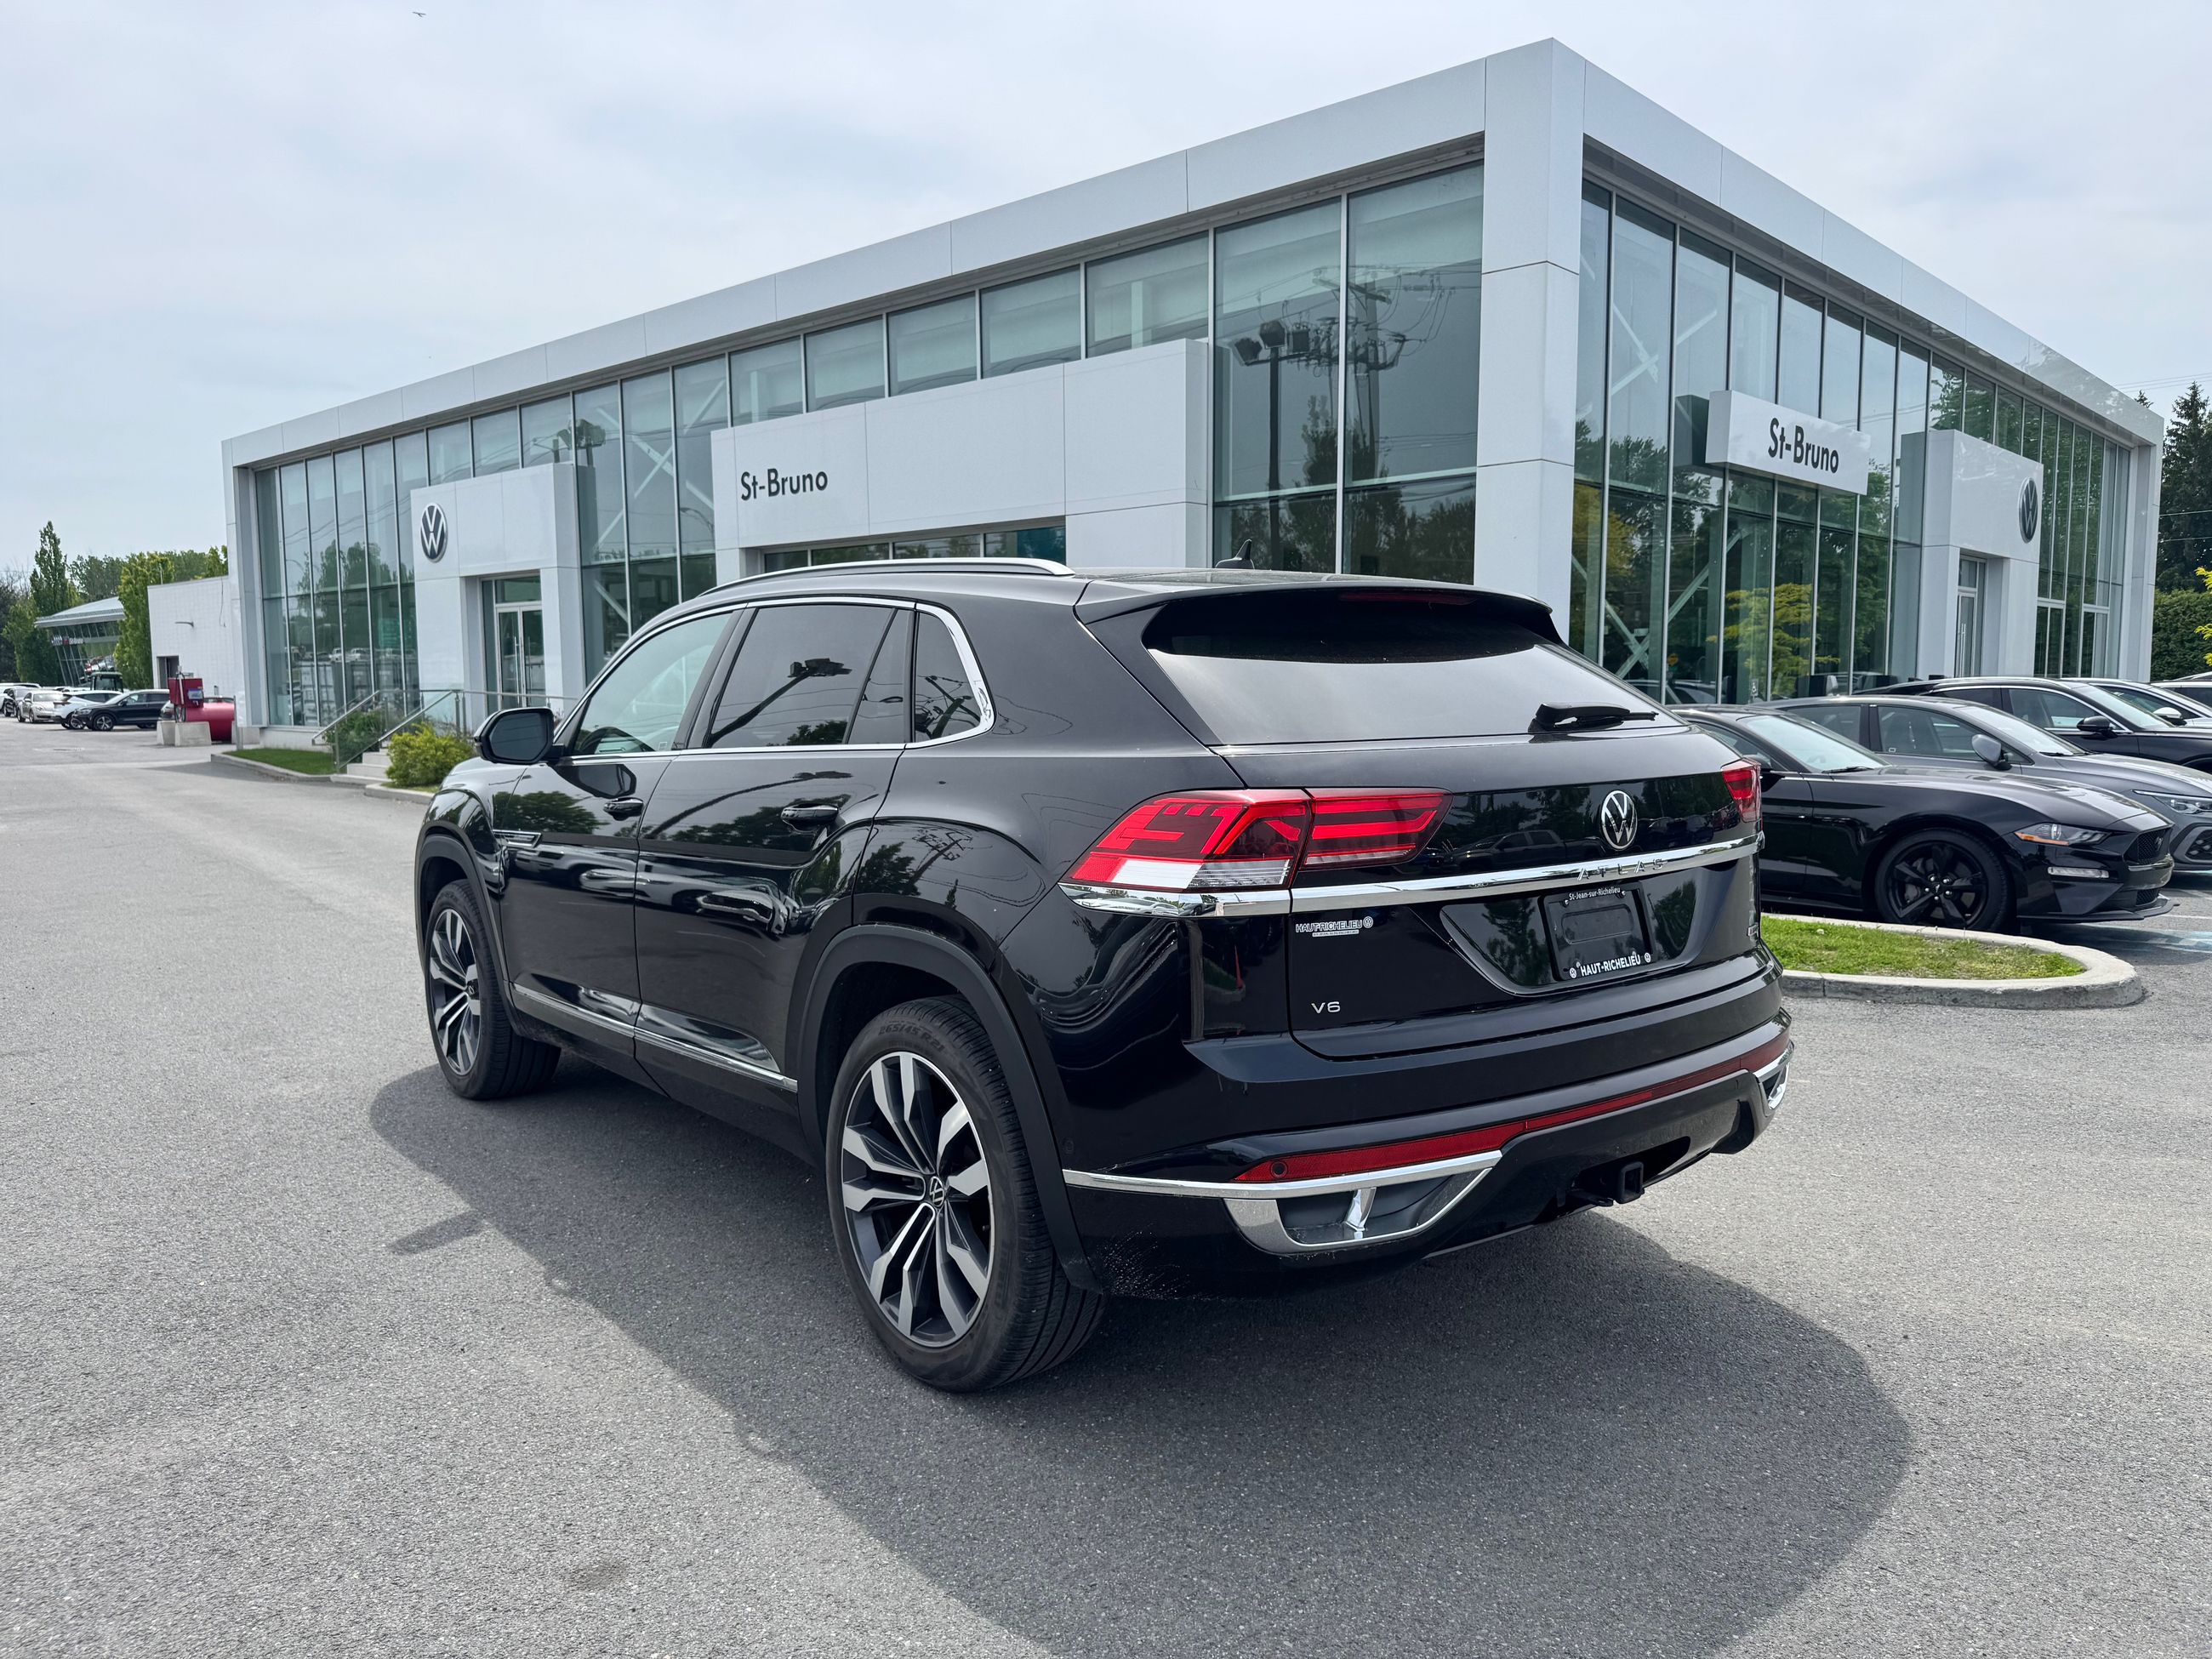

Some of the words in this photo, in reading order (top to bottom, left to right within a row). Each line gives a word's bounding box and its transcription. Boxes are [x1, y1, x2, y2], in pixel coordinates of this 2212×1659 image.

[1768, 417, 1839, 473] St-Bruno
[740, 468, 828, 501] St-Bruno
[1577, 858, 1664, 881] ATLAS
[1569, 887, 1621, 901] St-Jean-sur-Richelieu
[1580, 954, 1641, 977] HAUT-RICHELIEU
[1311, 1001, 1341, 1014] V6
